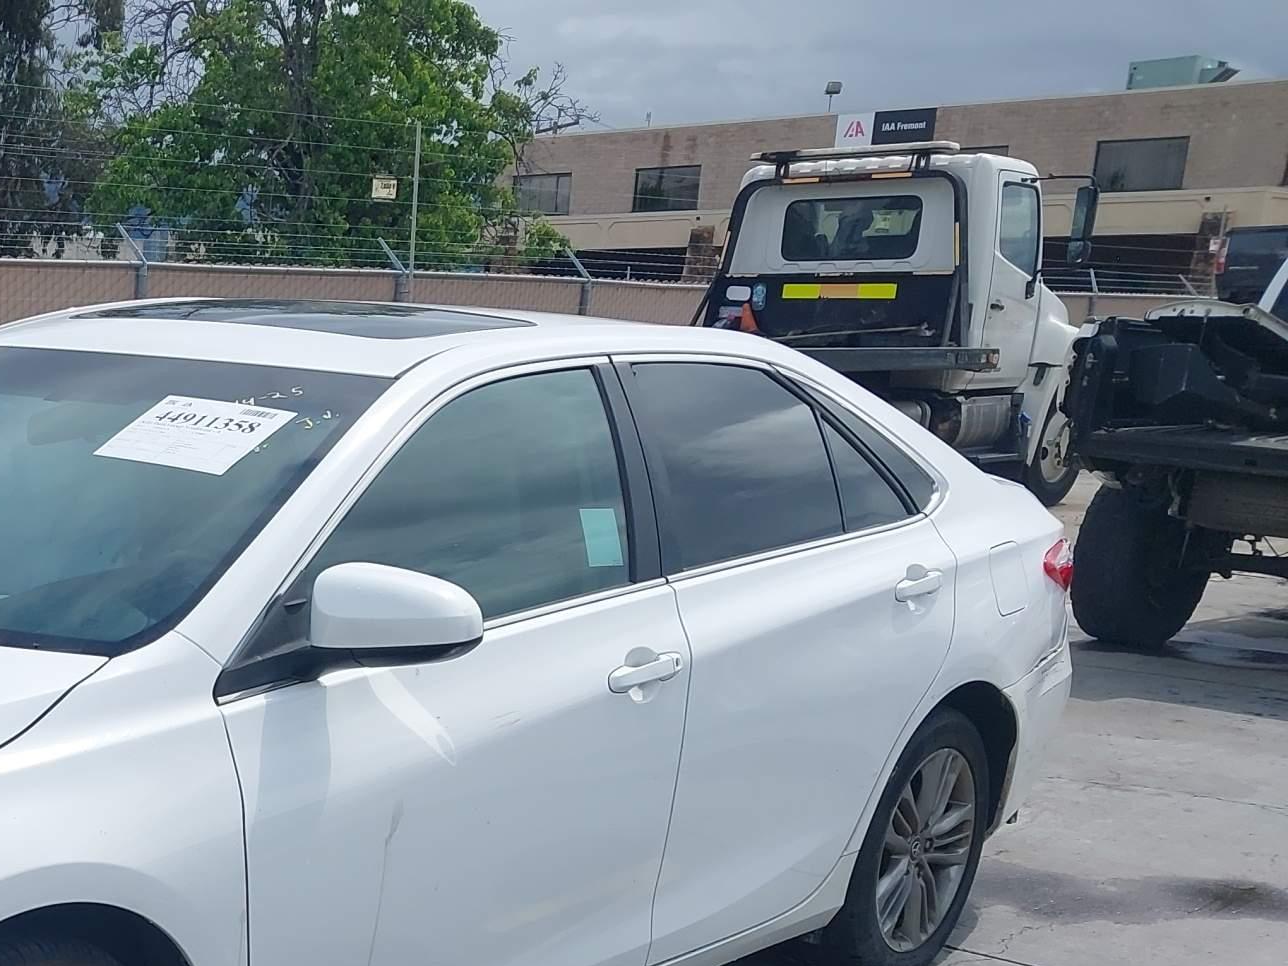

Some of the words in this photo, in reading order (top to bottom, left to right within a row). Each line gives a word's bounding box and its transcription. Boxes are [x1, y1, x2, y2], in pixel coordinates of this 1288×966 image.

[881, 122, 895, 131] IAA
[896, 121, 926, 130] Fremont
[155, 410, 261, 434] 44911358
